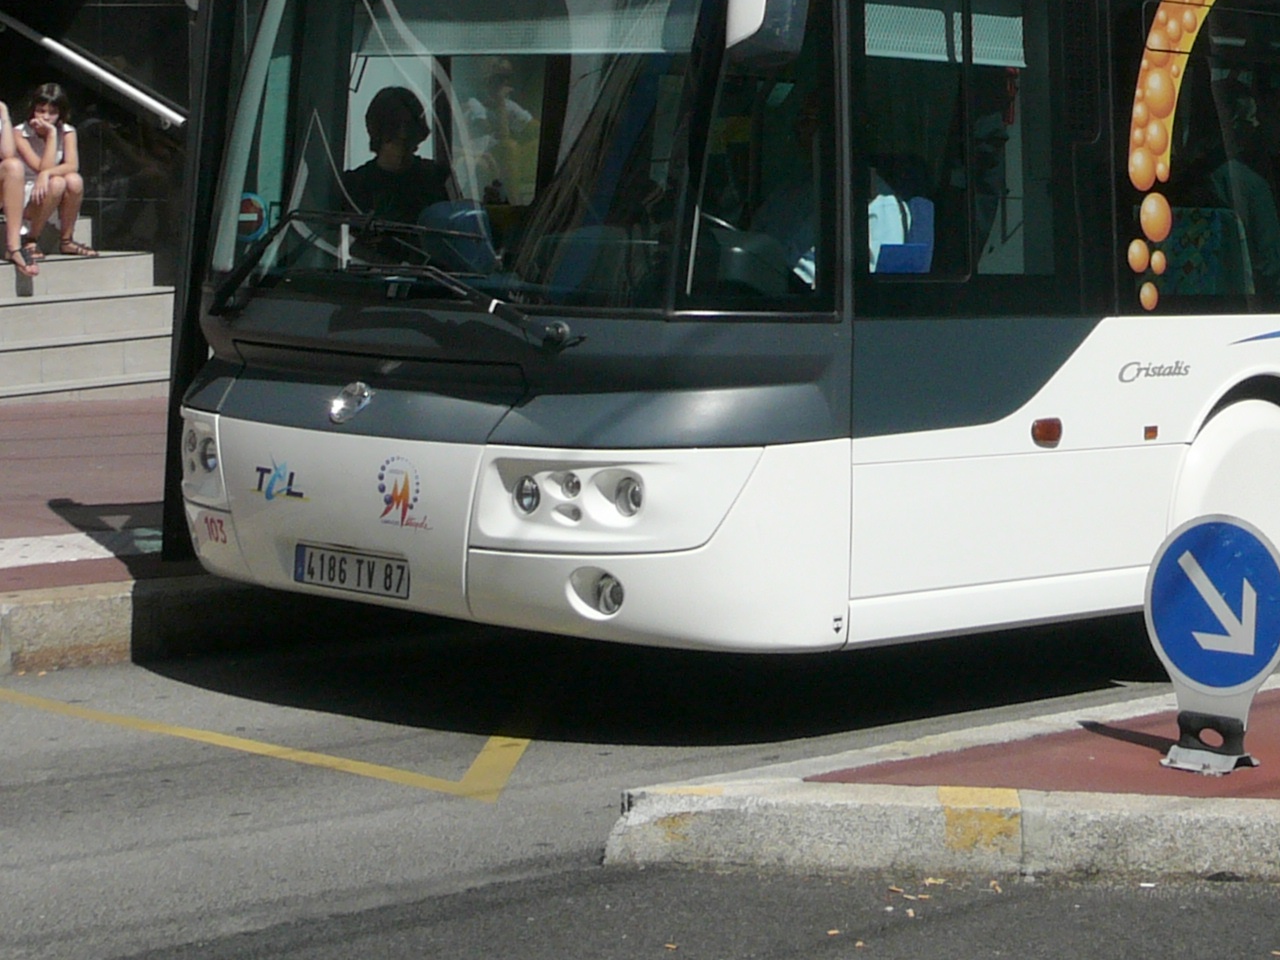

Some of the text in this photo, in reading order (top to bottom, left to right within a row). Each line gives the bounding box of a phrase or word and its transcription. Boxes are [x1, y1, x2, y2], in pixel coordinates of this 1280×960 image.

[1118, 360, 1191, 383] Cristalis
[204, 516, 227, 544] 103
[307, 551, 405, 593] 4186 TV 87
